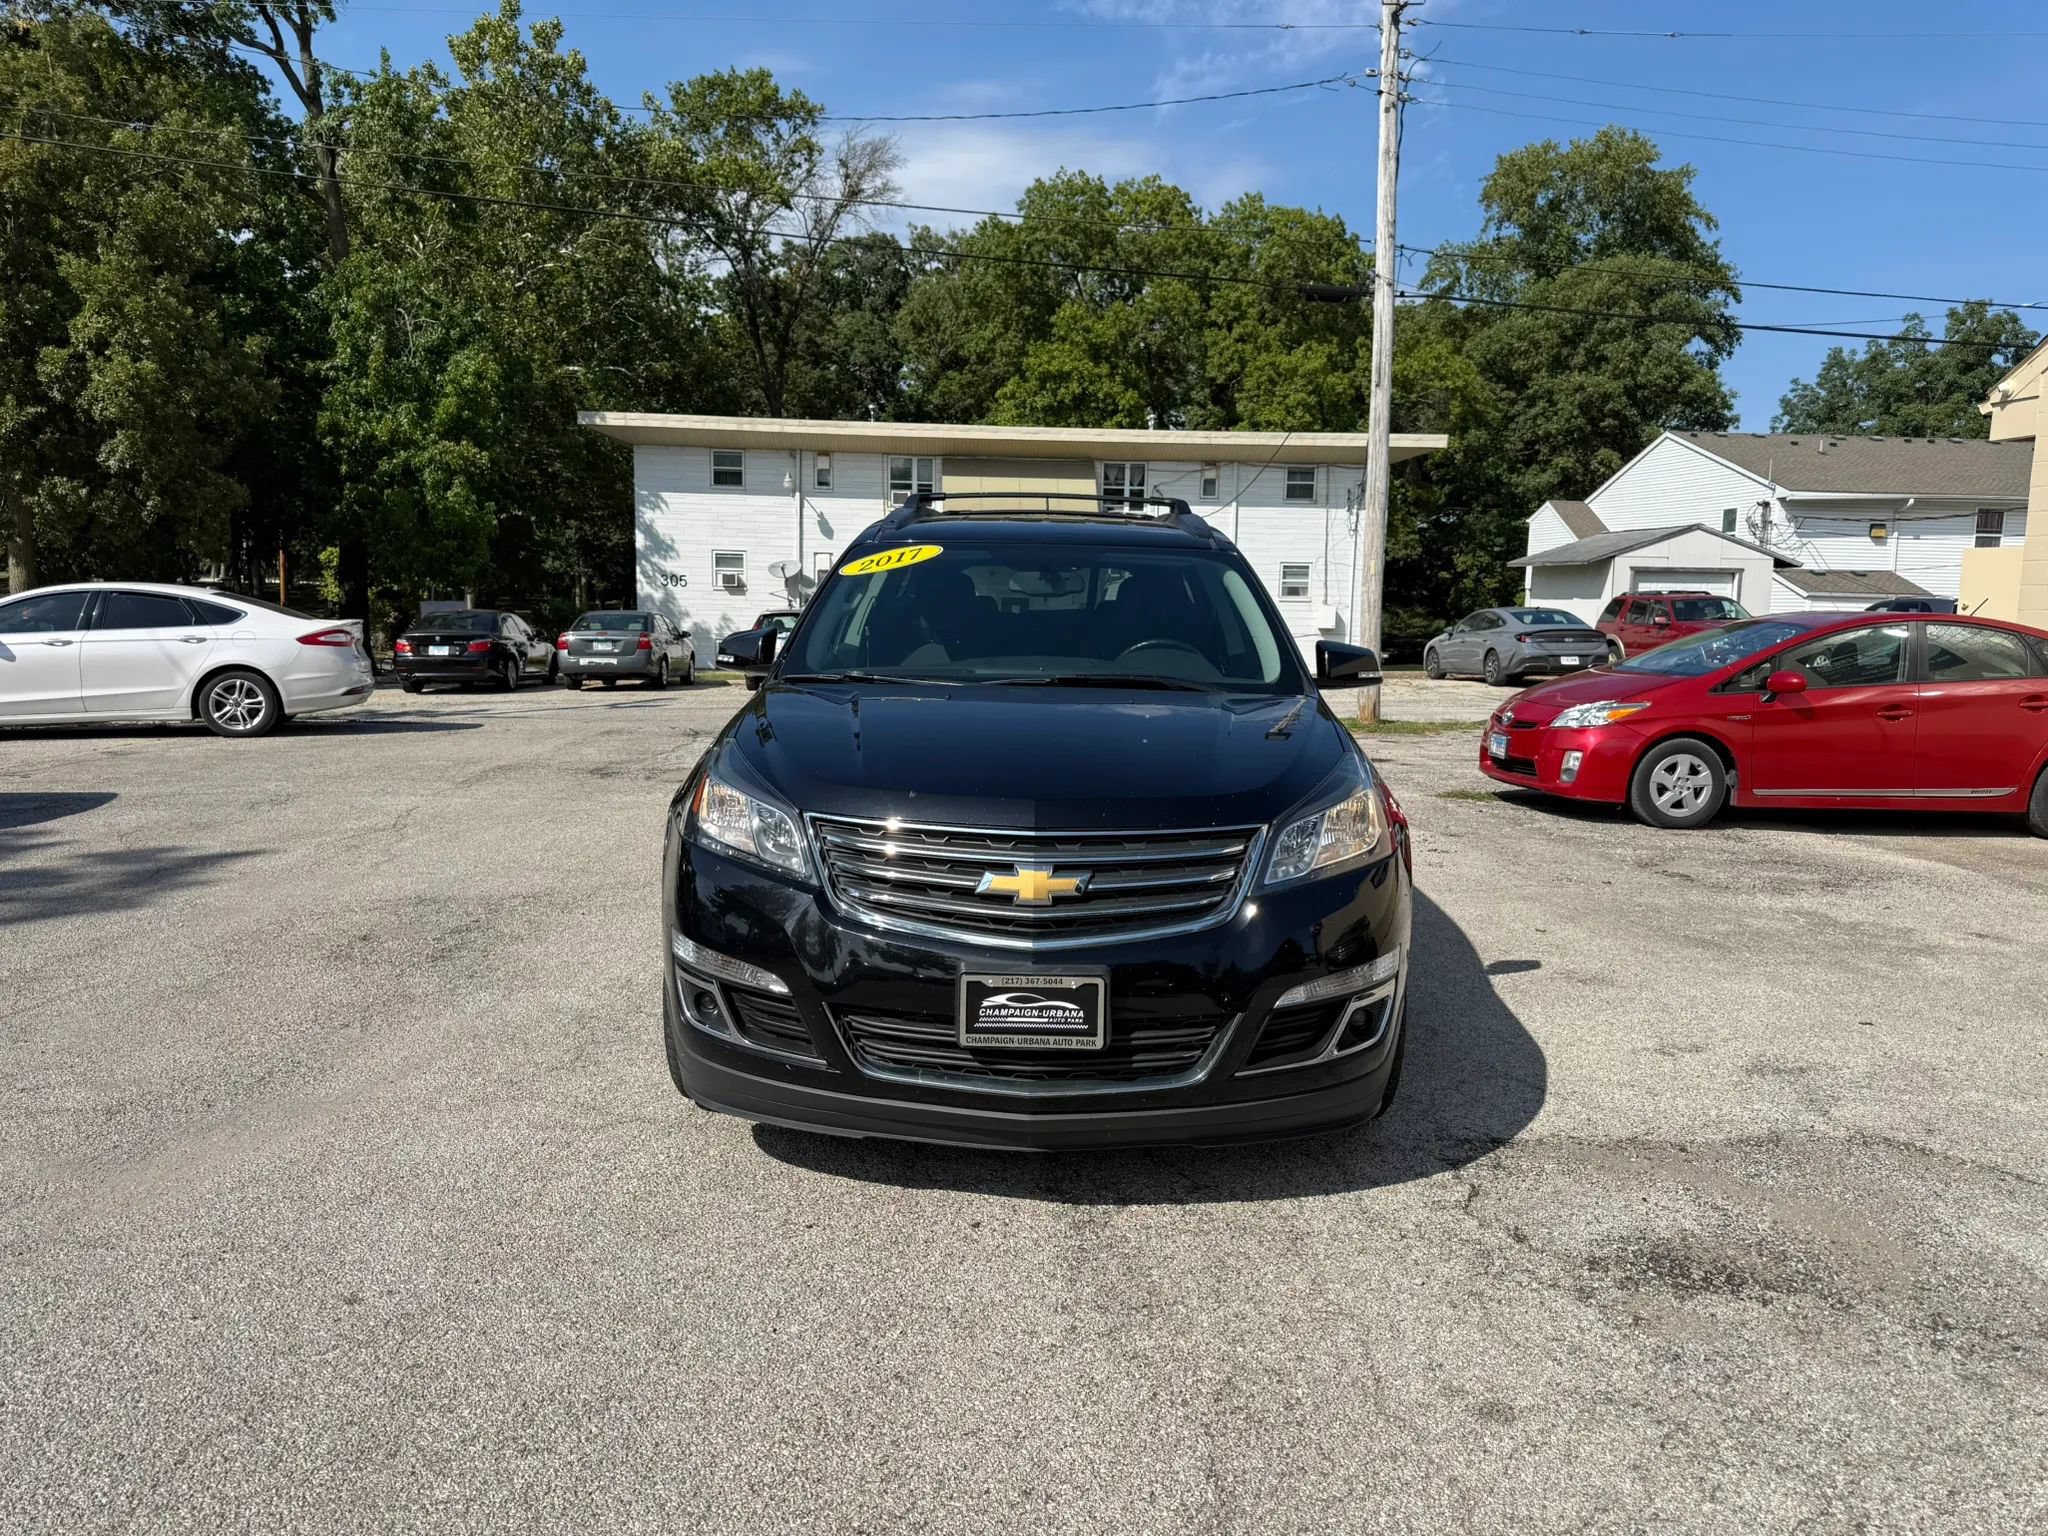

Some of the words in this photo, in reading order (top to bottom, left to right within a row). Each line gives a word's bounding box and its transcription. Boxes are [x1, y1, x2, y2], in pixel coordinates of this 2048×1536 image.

[858, 547, 923, 573] 2017
[660, 573, 688, 588] 305
[1001, 976, 1023, 986] (217)
[1025, 977, 1063, 986] 367-5044
[979, 1008, 1084, 1018] CHAMPAIGN-URBANA
[965, 1035, 1051, 1046] CHAMPAIGN-URBANA
[1052, 1037, 1073, 1047] AUTO
[1075, 1038, 1097, 1048] PARK
